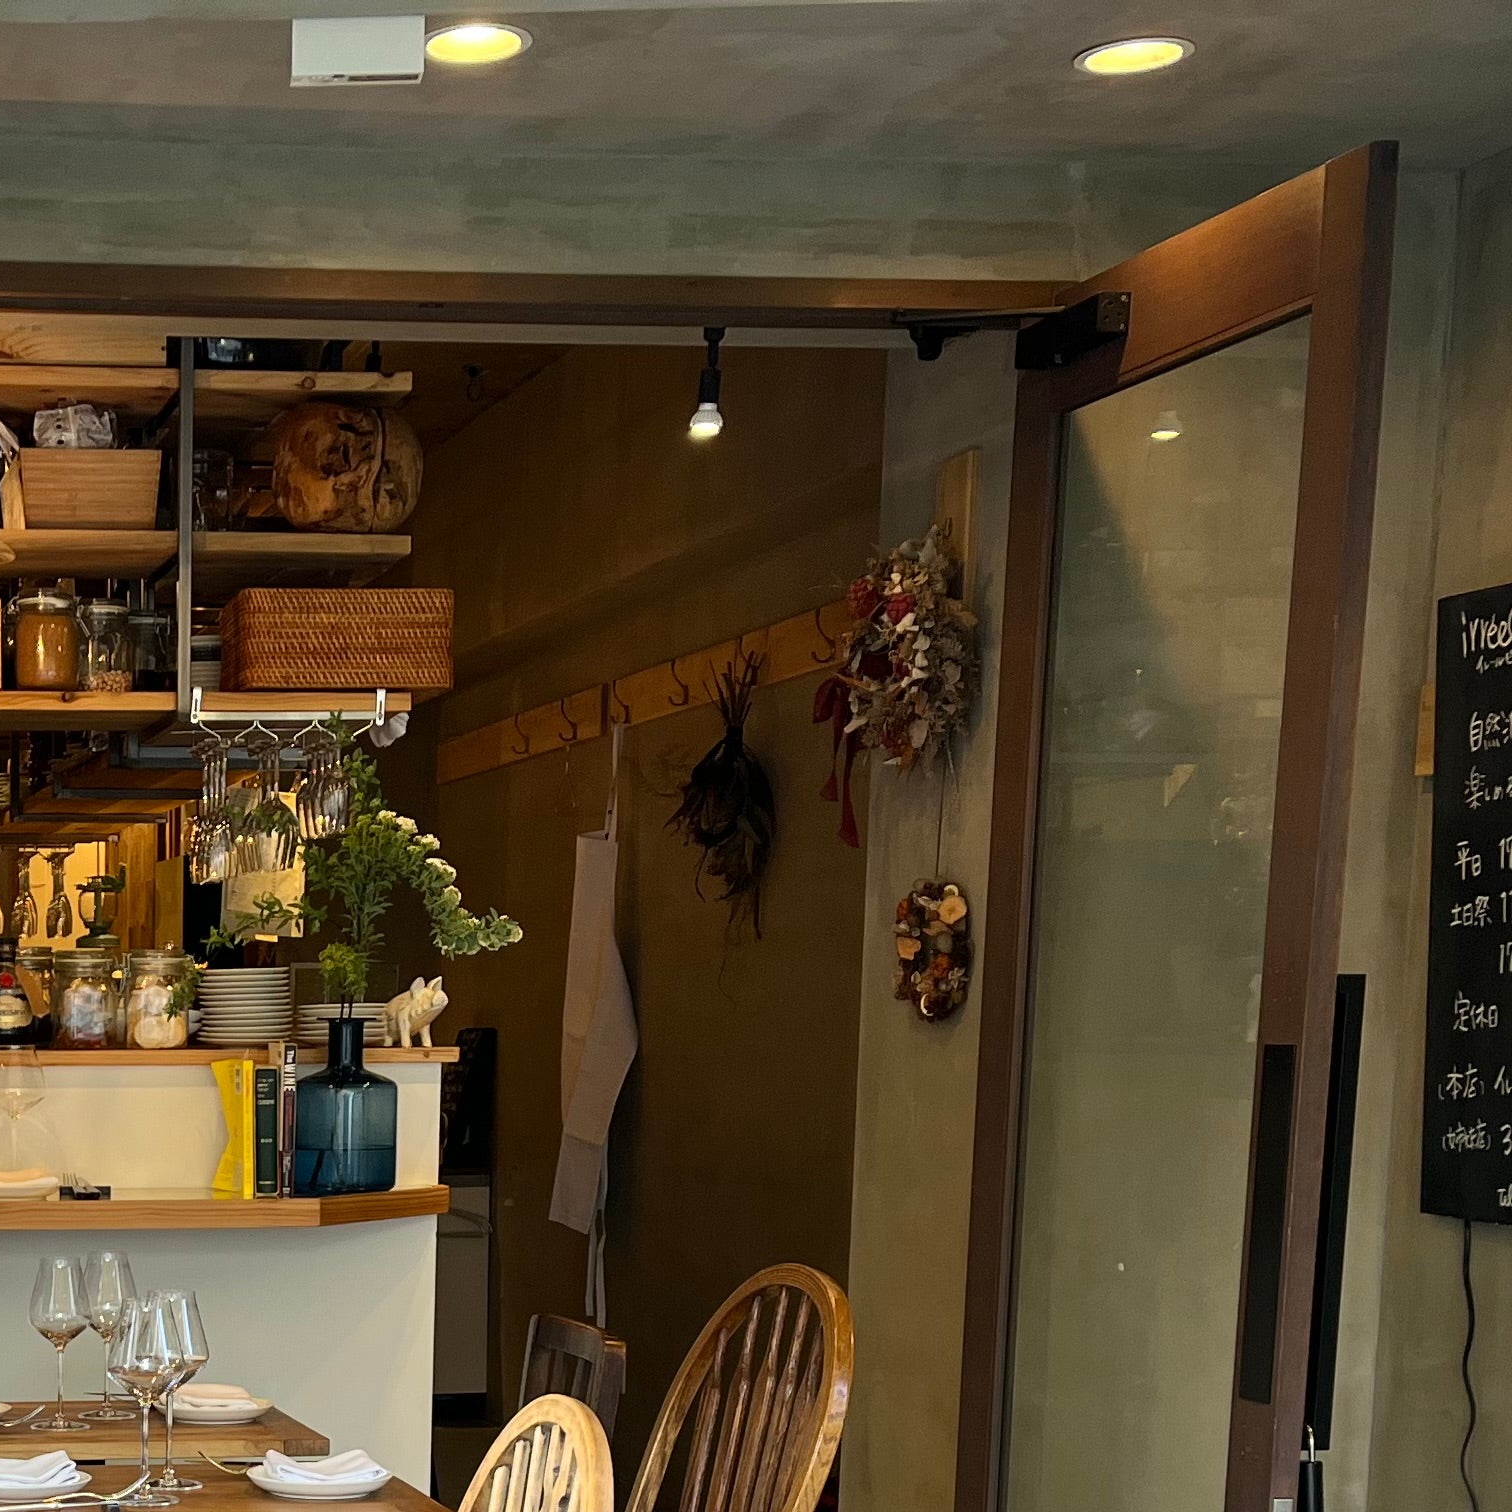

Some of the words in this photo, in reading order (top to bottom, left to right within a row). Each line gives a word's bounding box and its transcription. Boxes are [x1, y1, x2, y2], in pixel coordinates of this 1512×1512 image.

[1454, 840, 1482, 880] 平日
[1450, 896, 1493, 927] 土日祭
[1453, 990, 1498, 1031] 定休日
[284, 1064, 296, 1091] WINE
